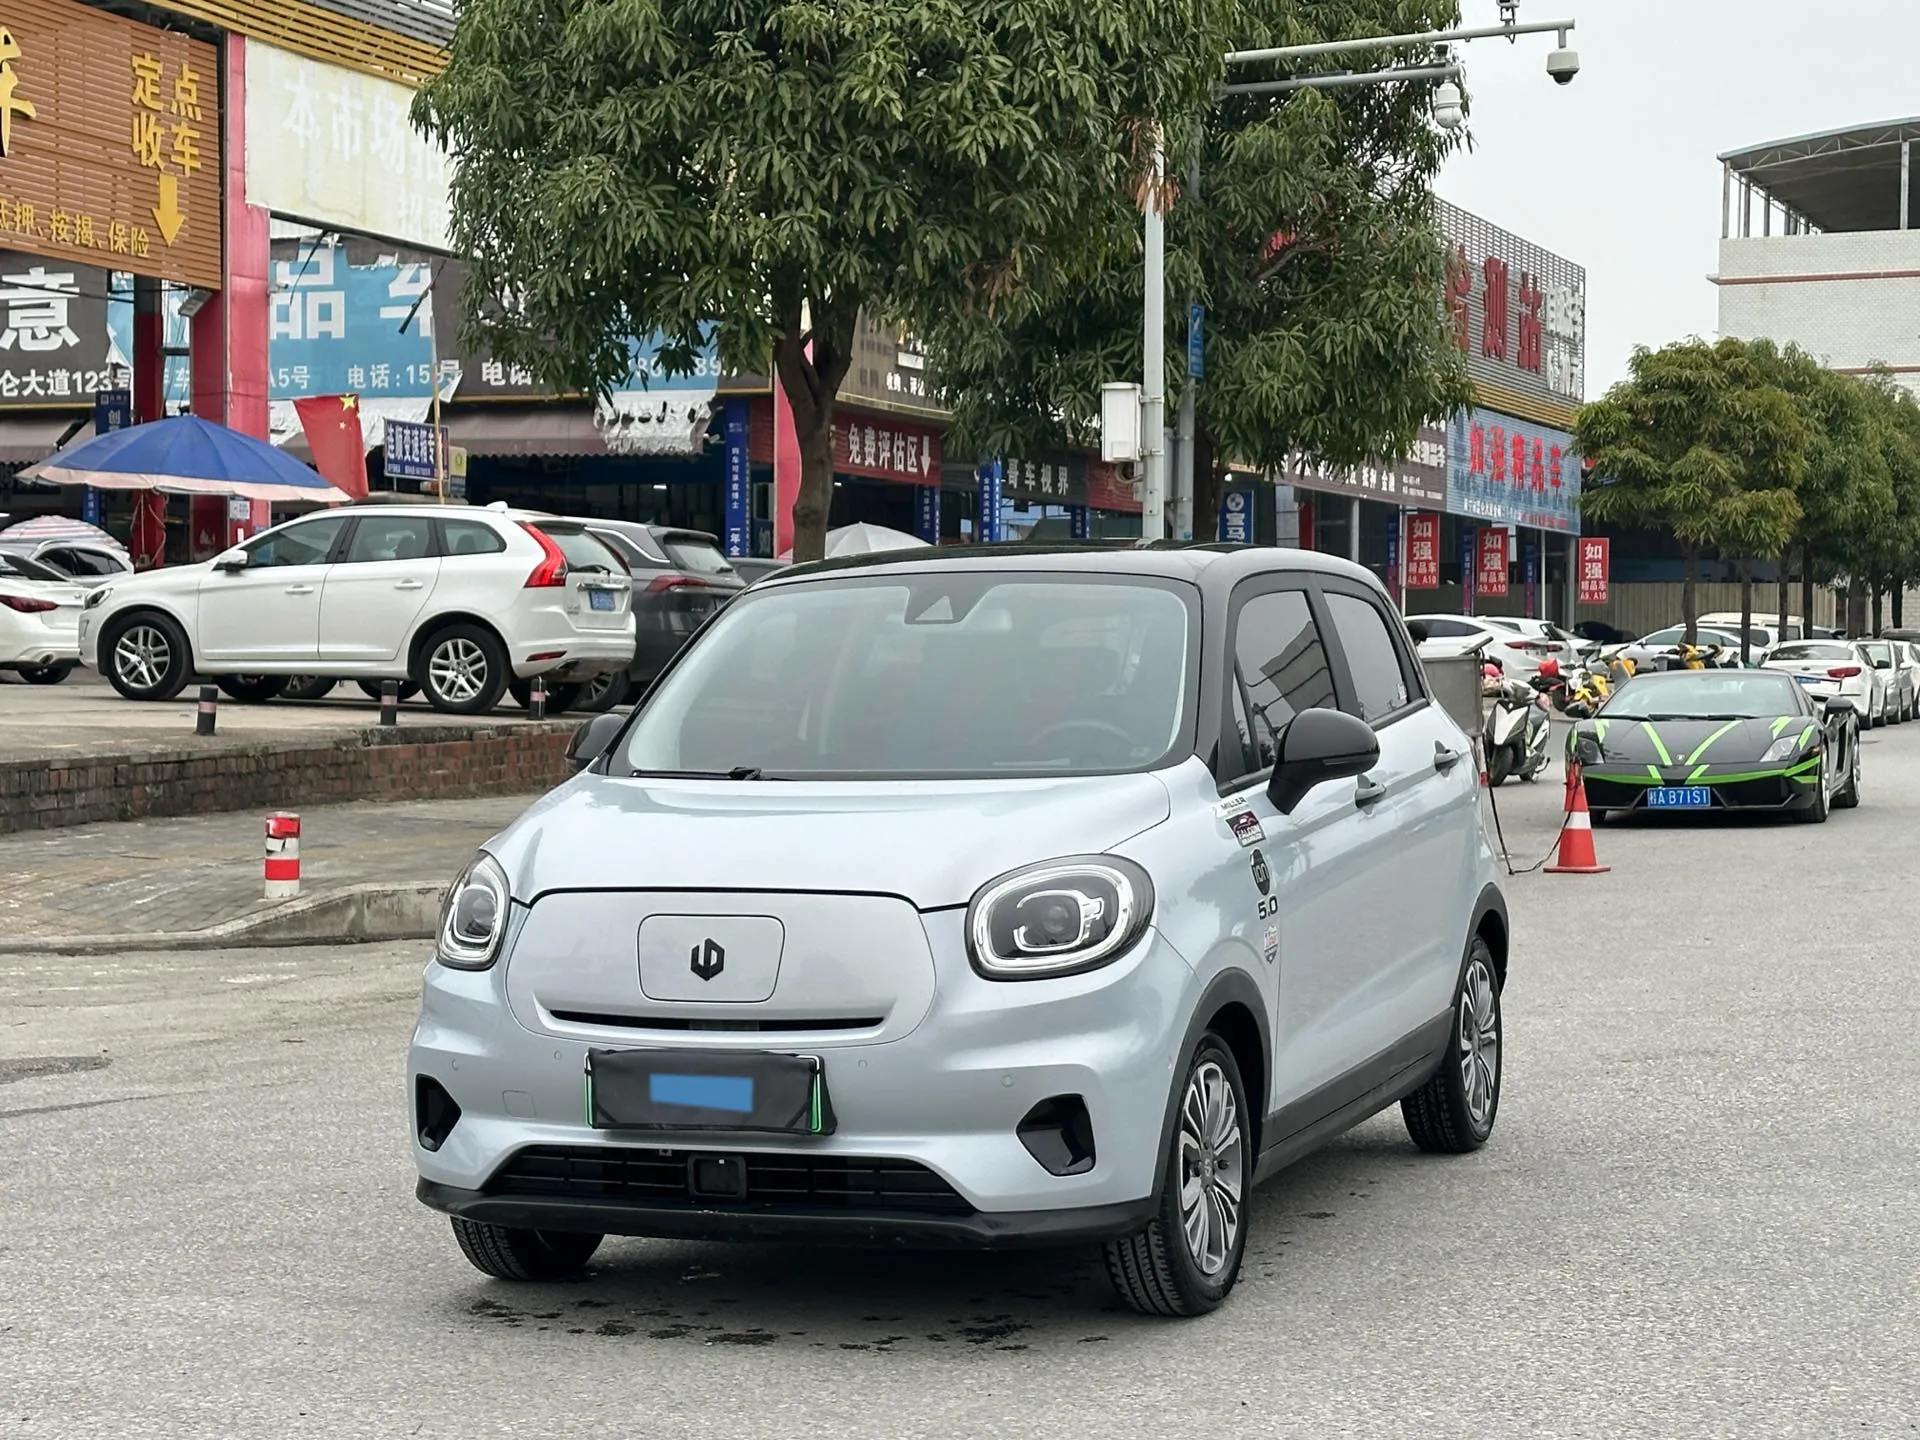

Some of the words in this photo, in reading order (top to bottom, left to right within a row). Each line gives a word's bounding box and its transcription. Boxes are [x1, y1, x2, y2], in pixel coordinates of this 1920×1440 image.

[131, 52, 202, 122] 定点
[132, 113, 202, 178] 收车
[1, 266, 80, 352] 意
[848, 422, 918, 475] 免费评估区
[1412, 518, 1432, 561] 如强
[1483, 532, 1503, 570] 如强
[1584, 542, 1602, 579] 如强
[1257, 896, 1278, 920] 5.0
